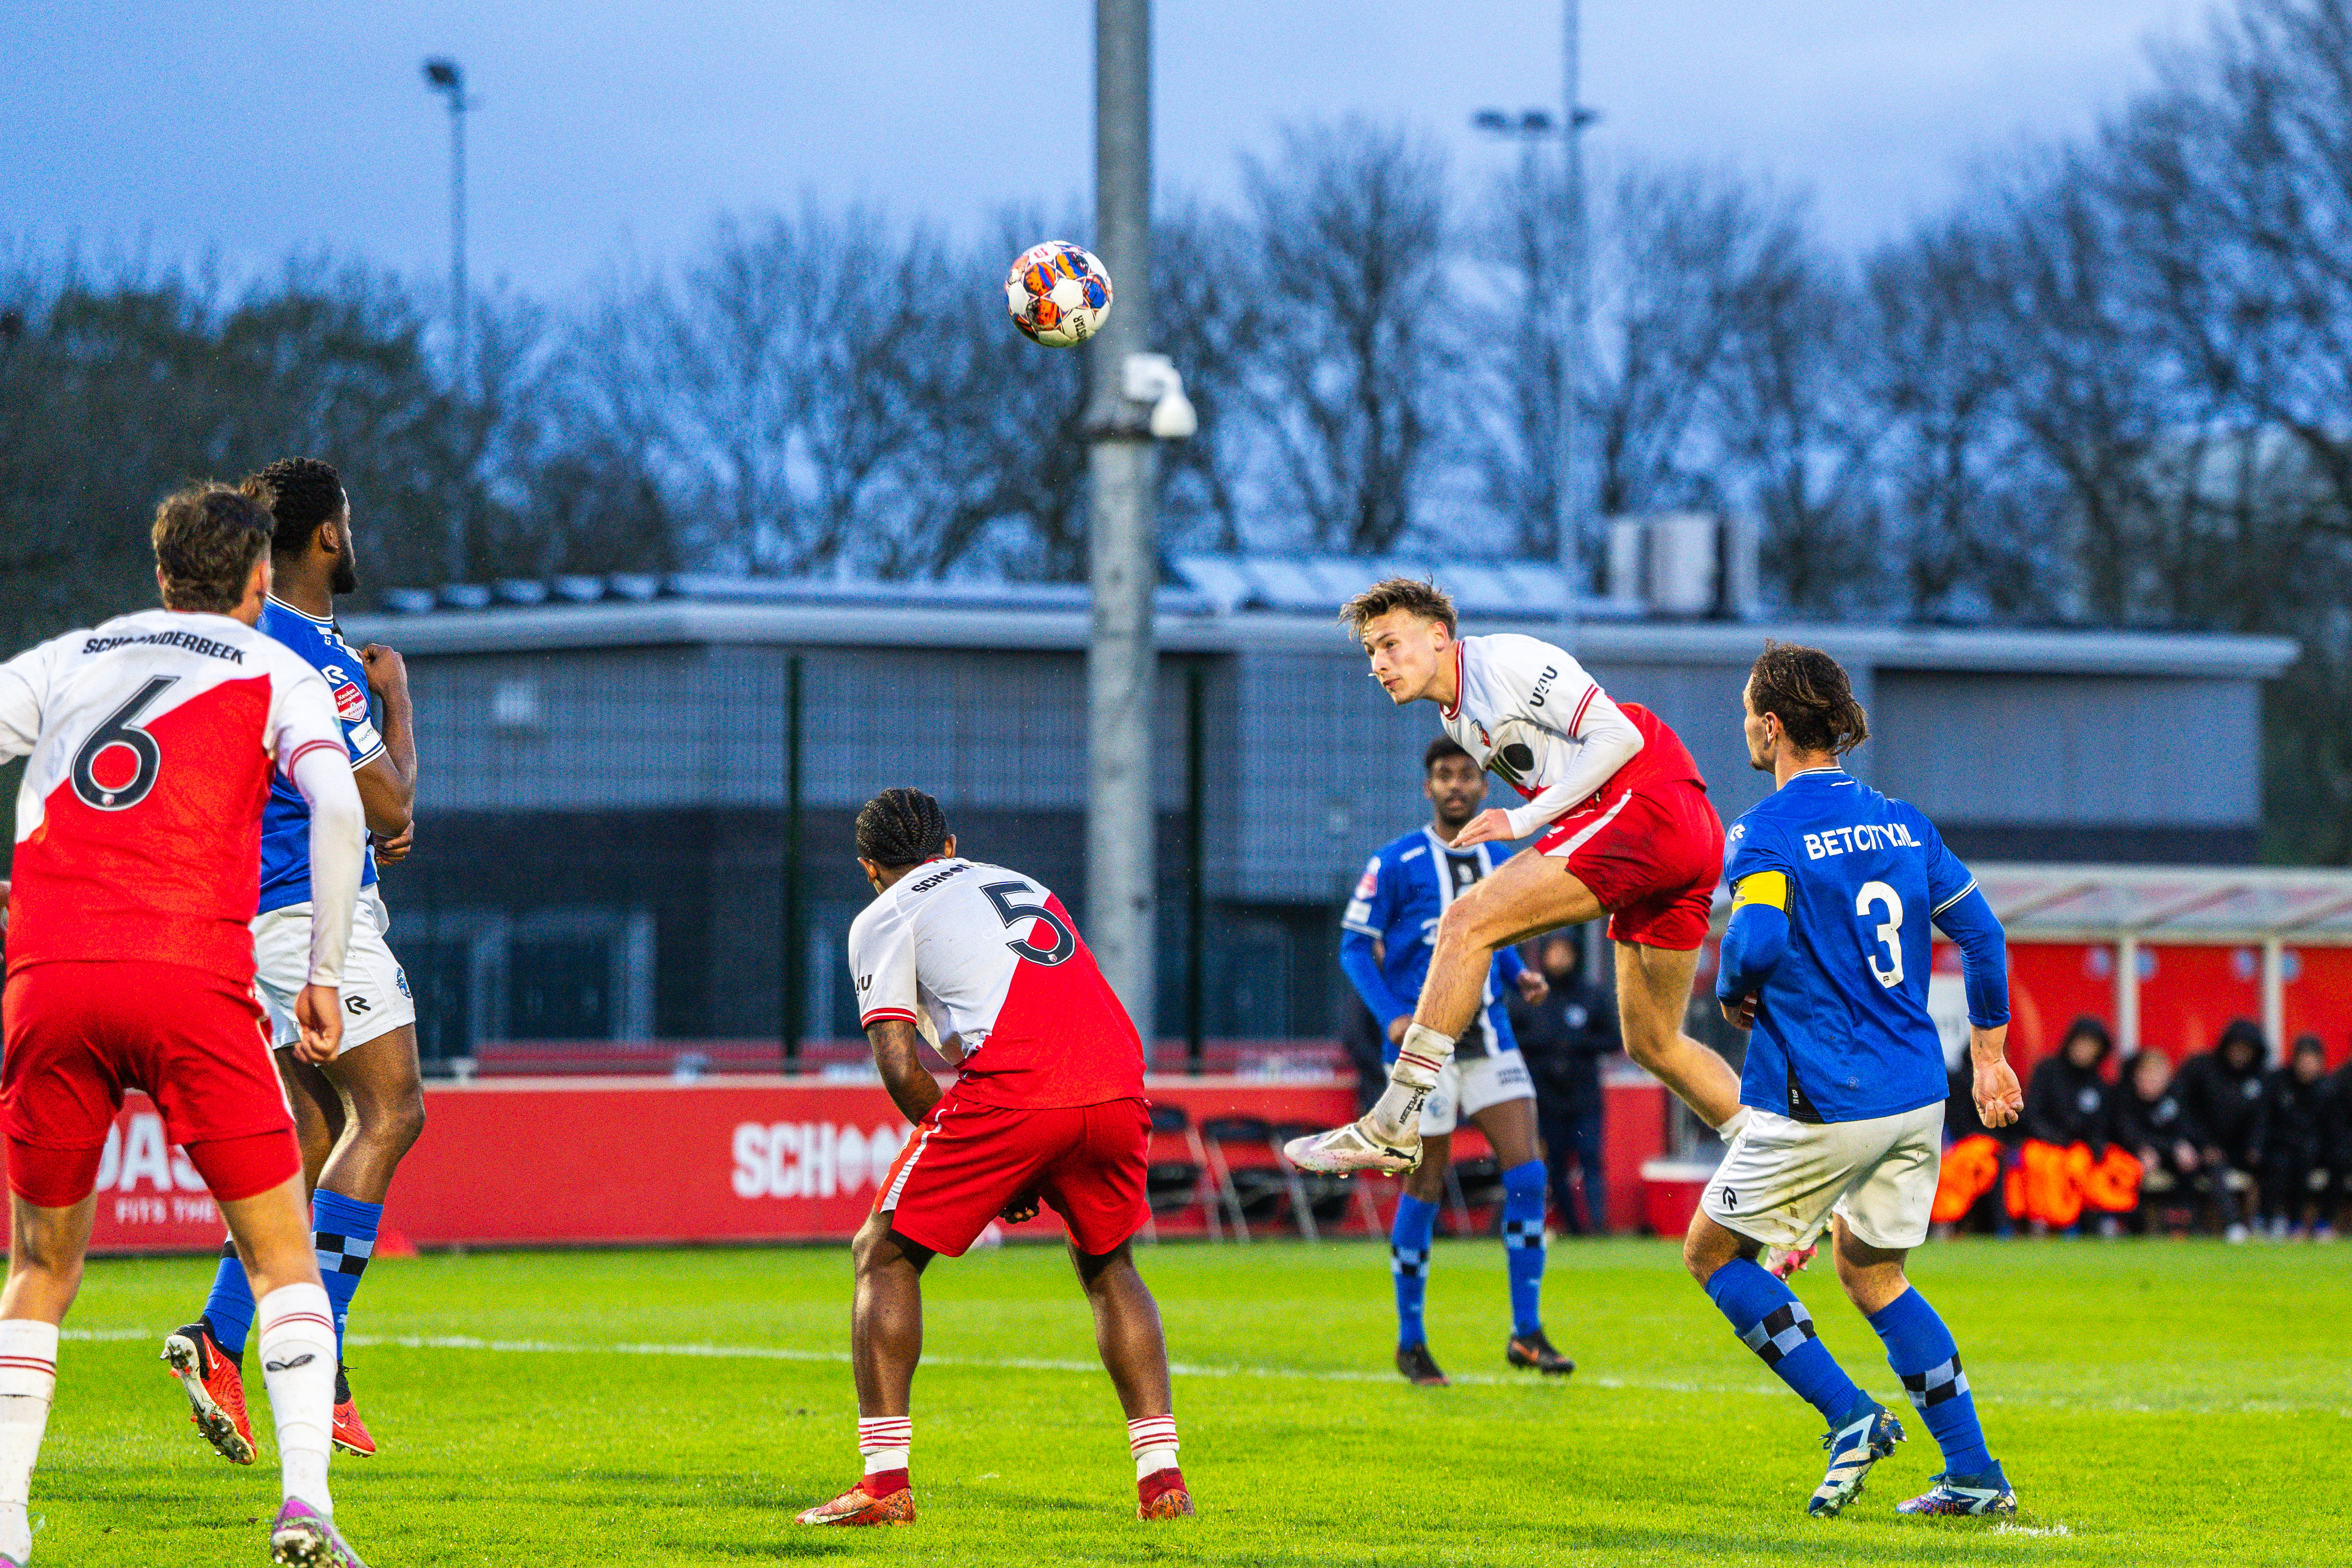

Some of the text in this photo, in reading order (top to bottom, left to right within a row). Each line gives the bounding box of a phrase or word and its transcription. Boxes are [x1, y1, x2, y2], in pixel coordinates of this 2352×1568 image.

[1073, 315, 1087, 341] STAR
[337, 688, 356, 701] Keuken
[337, 691, 361, 706] Kampioen
[70, 674, 182, 812] 6
[979, 881, 1076, 967] 5
[1856, 881, 1904, 989] 3
